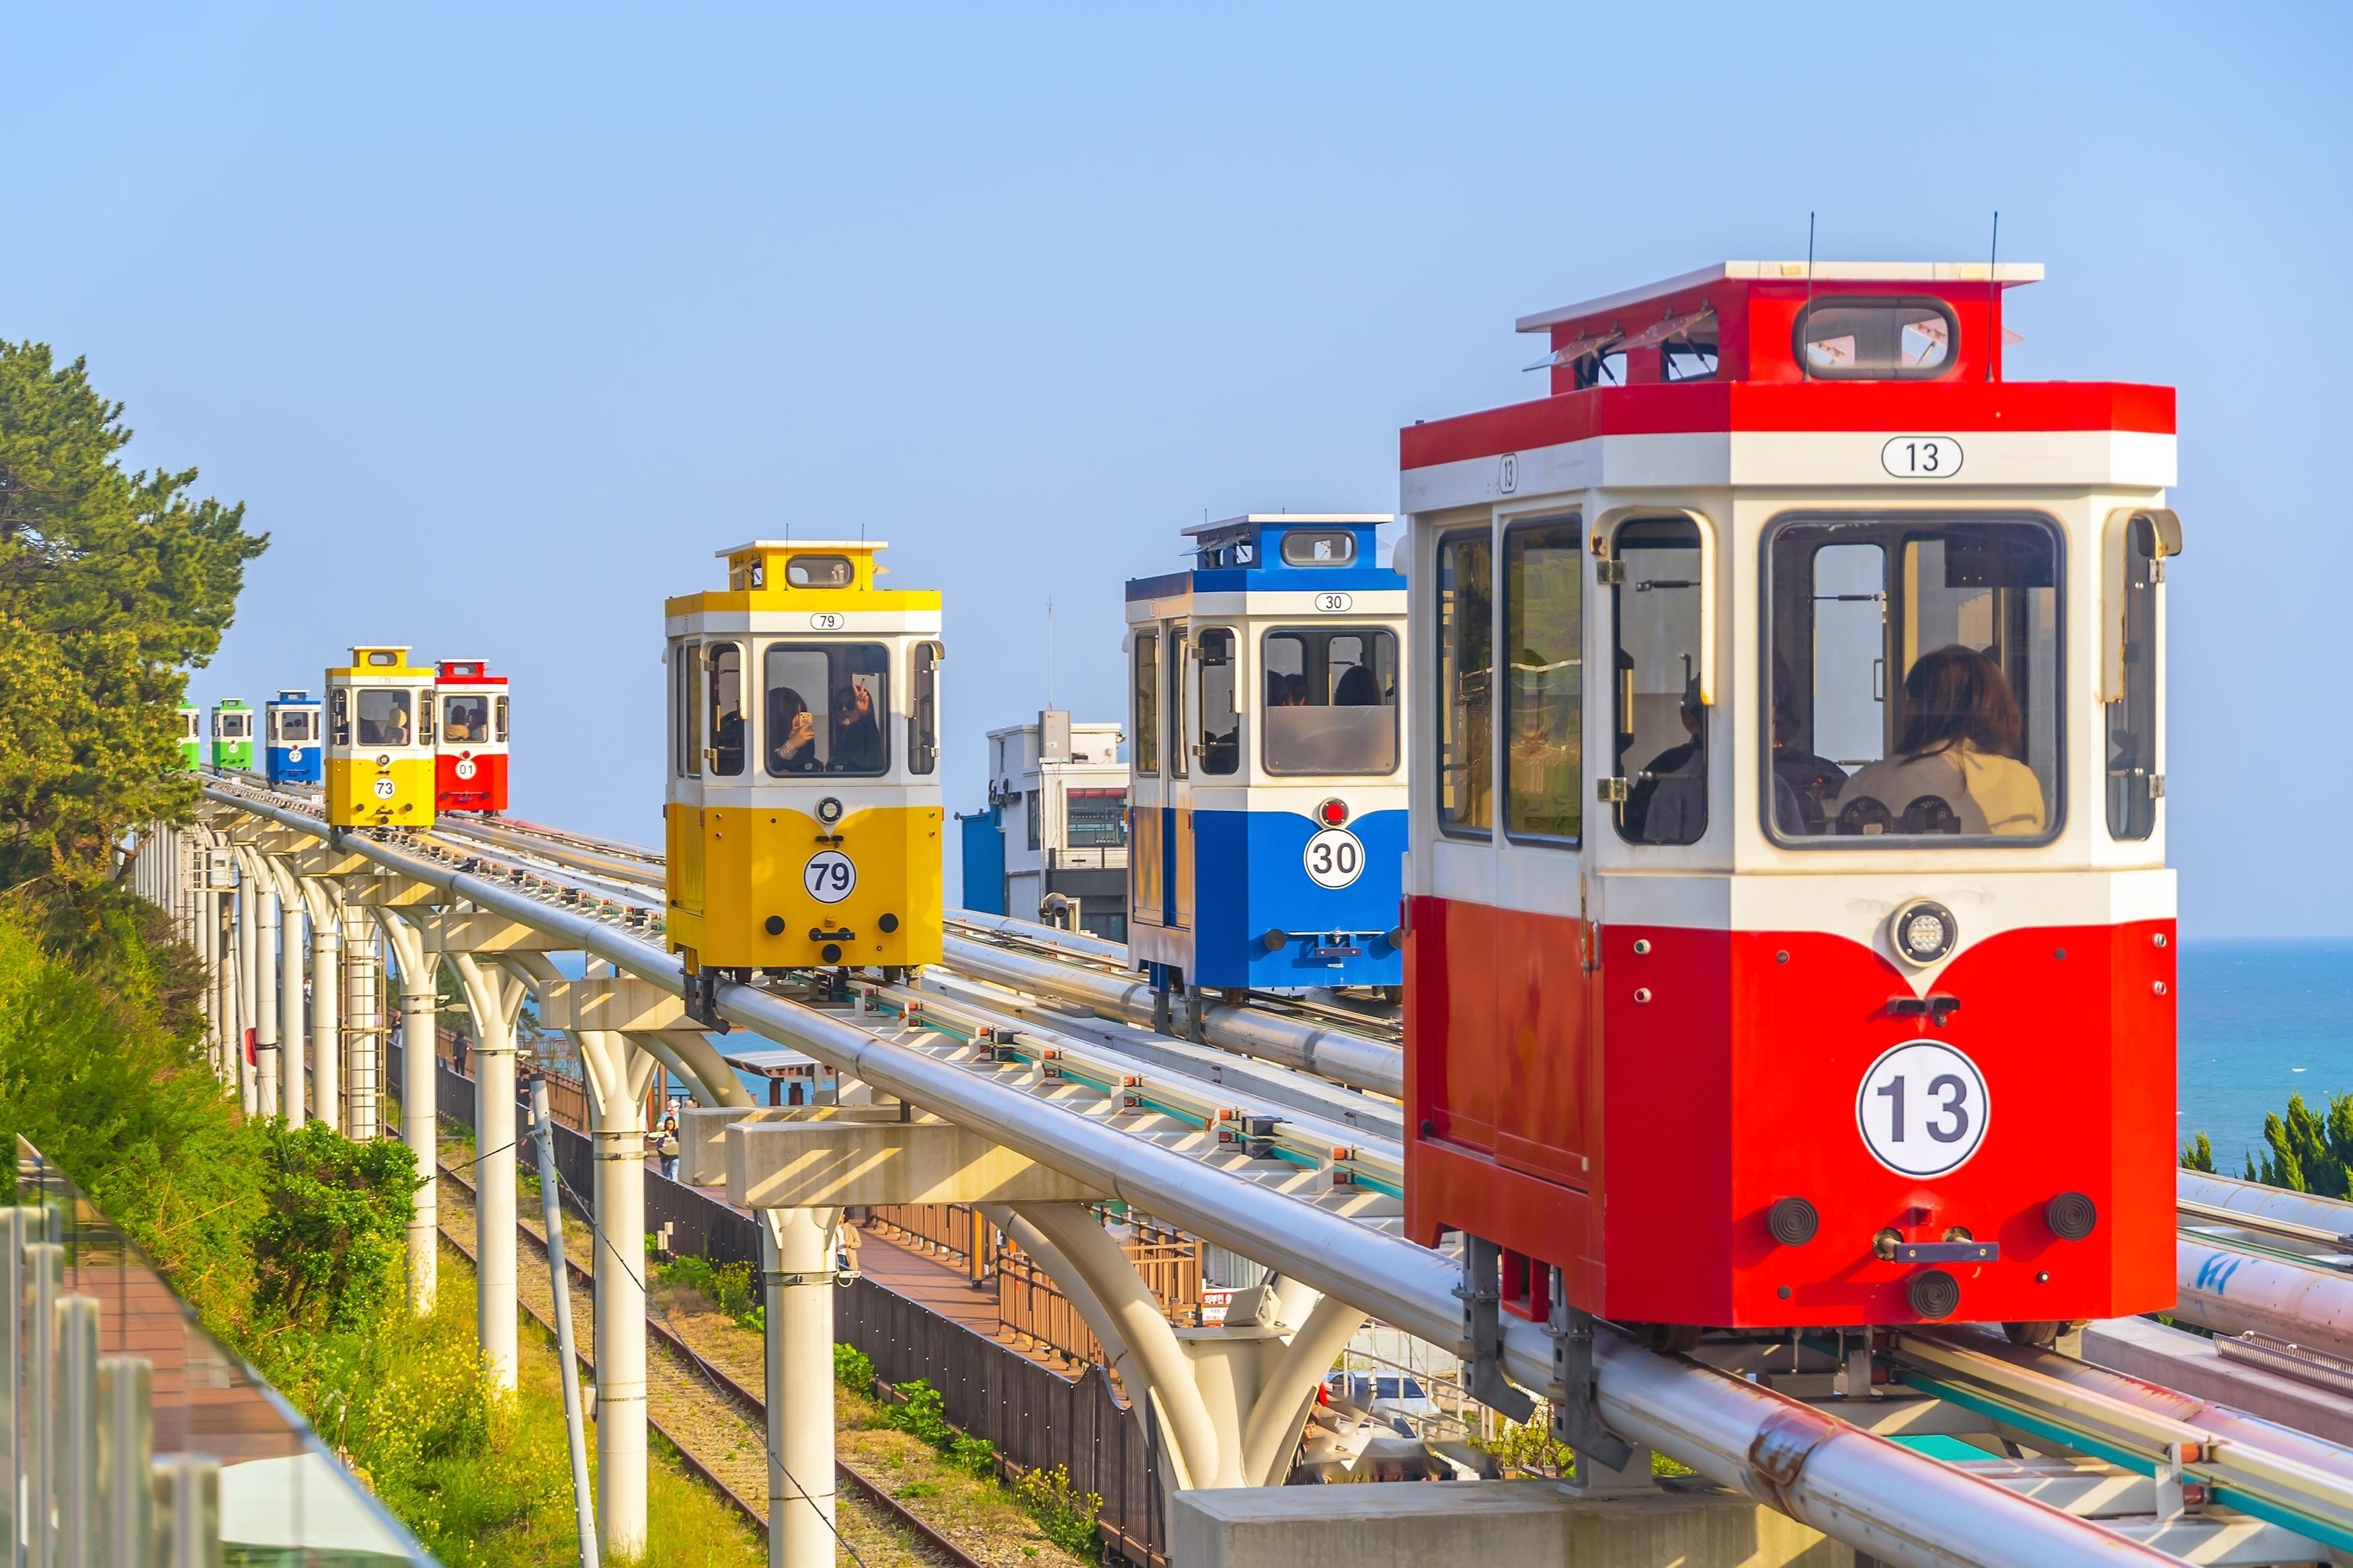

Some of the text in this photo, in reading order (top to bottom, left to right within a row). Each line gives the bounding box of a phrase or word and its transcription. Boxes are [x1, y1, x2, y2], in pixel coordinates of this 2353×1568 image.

[1906, 443, 1938, 472] 13
[1504, 460, 1513, 487] 13
[1326, 595, 1342, 609] 30
[820, 615, 834, 627] 79
[460, 764, 473, 774] 01
[376, 782, 393, 794] 73
[1313, 842, 1356, 874] 30
[810, 862, 850, 891] 79
[1877, 1074, 1969, 1143] 13
[1204, 1294, 1224, 1305] 외부인
